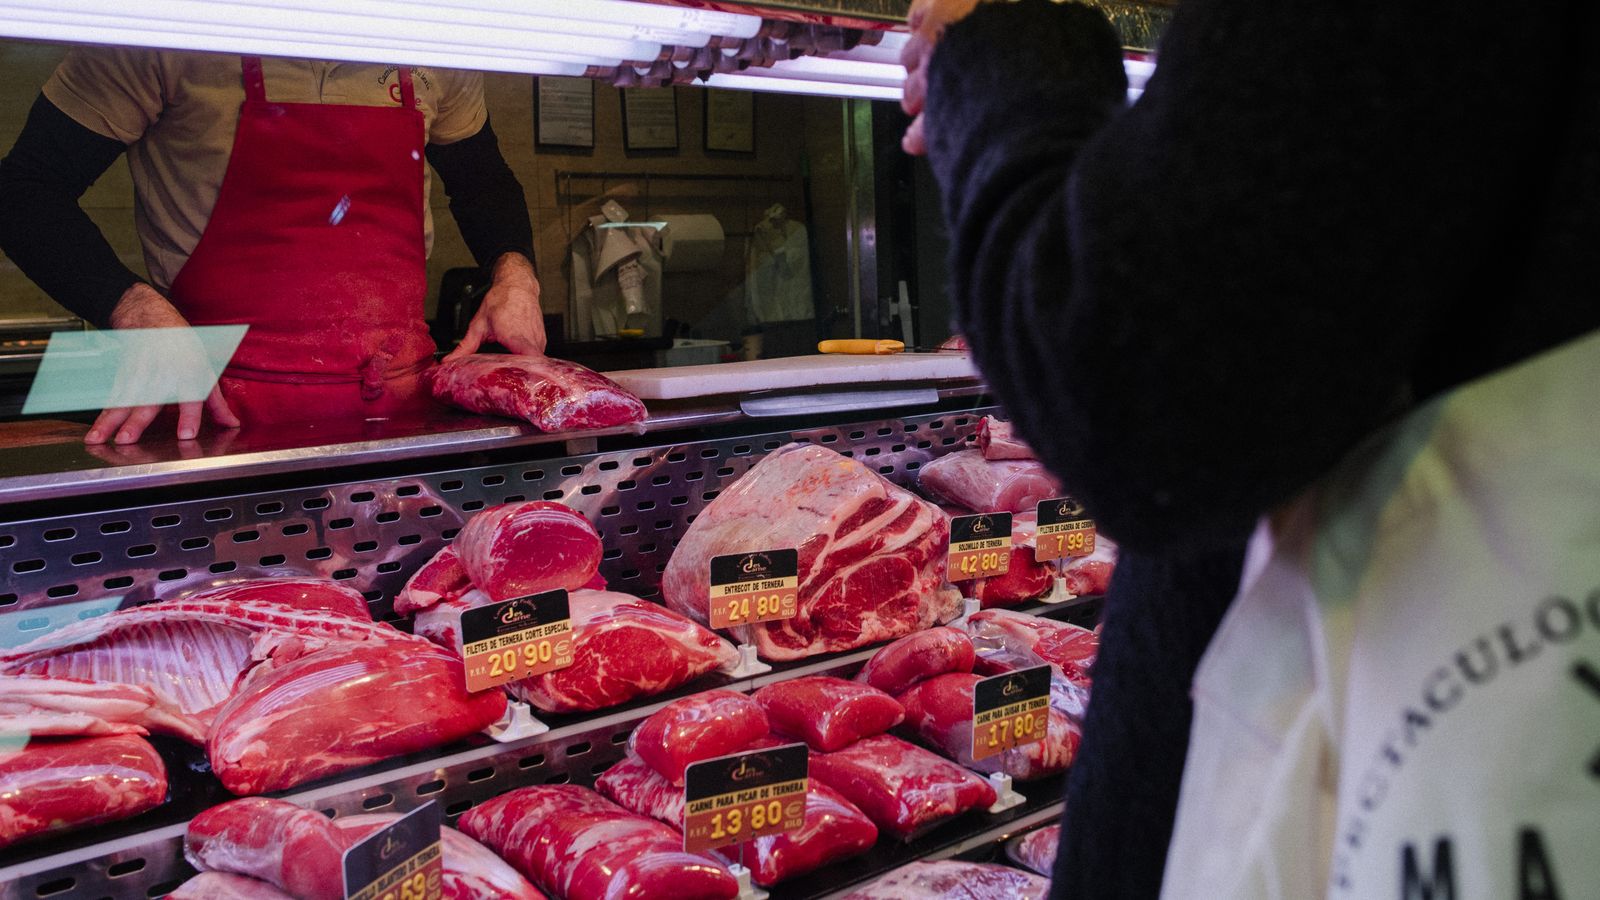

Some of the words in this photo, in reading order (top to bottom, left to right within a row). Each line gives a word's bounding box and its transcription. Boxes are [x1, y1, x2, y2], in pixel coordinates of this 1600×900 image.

[1075, 522, 1081, 530] DE
[958, 542, 979, 551] SOLOMILLO
[980, 541, 985, 549] DE
[985, 539, 1003, 548] TERNERA
[1056, 532, 1084, 552] 7'99
[960, 552, 998, 574] 42'80
[724, 584, 751, 595] ENTRECOT
[752, 583, 760, 591] DE
[761, 580, 785, 589] TERNERA
[728, 594, 780, 621] 24'80
[466, 644, 488, 656] FILETES
[489, 641, 497, 649] DE
[499, 634, 523, 647] TERNERA
[525, 628, 543, 640] CORTE
[544, 622, 569, 635] ESPECIAL
[487, 640, 552, 678] 20'90
[555, 655, 572, 666] KILO
[977, 713, 991, 725] CARNE
[991, 709, 1003, 719] PARA
[1021, 702, 1027, 711] DE
[1028, 698, 1048, 709] TERNERA
[988, 713, 1034, 747] 17'80
[690, 801, 713, 813] CARNE
[716, 795, 733, 807] PARA
[737, 790, 758, 802] PICAR
[760, 787, 769, 798] DE
[772, 782, 804, 796] TERNERA
[710, 801, 782, 839] 13'80
[408, 858, 416, 872] DE
[416, 845, 440, 867] TERNERA
